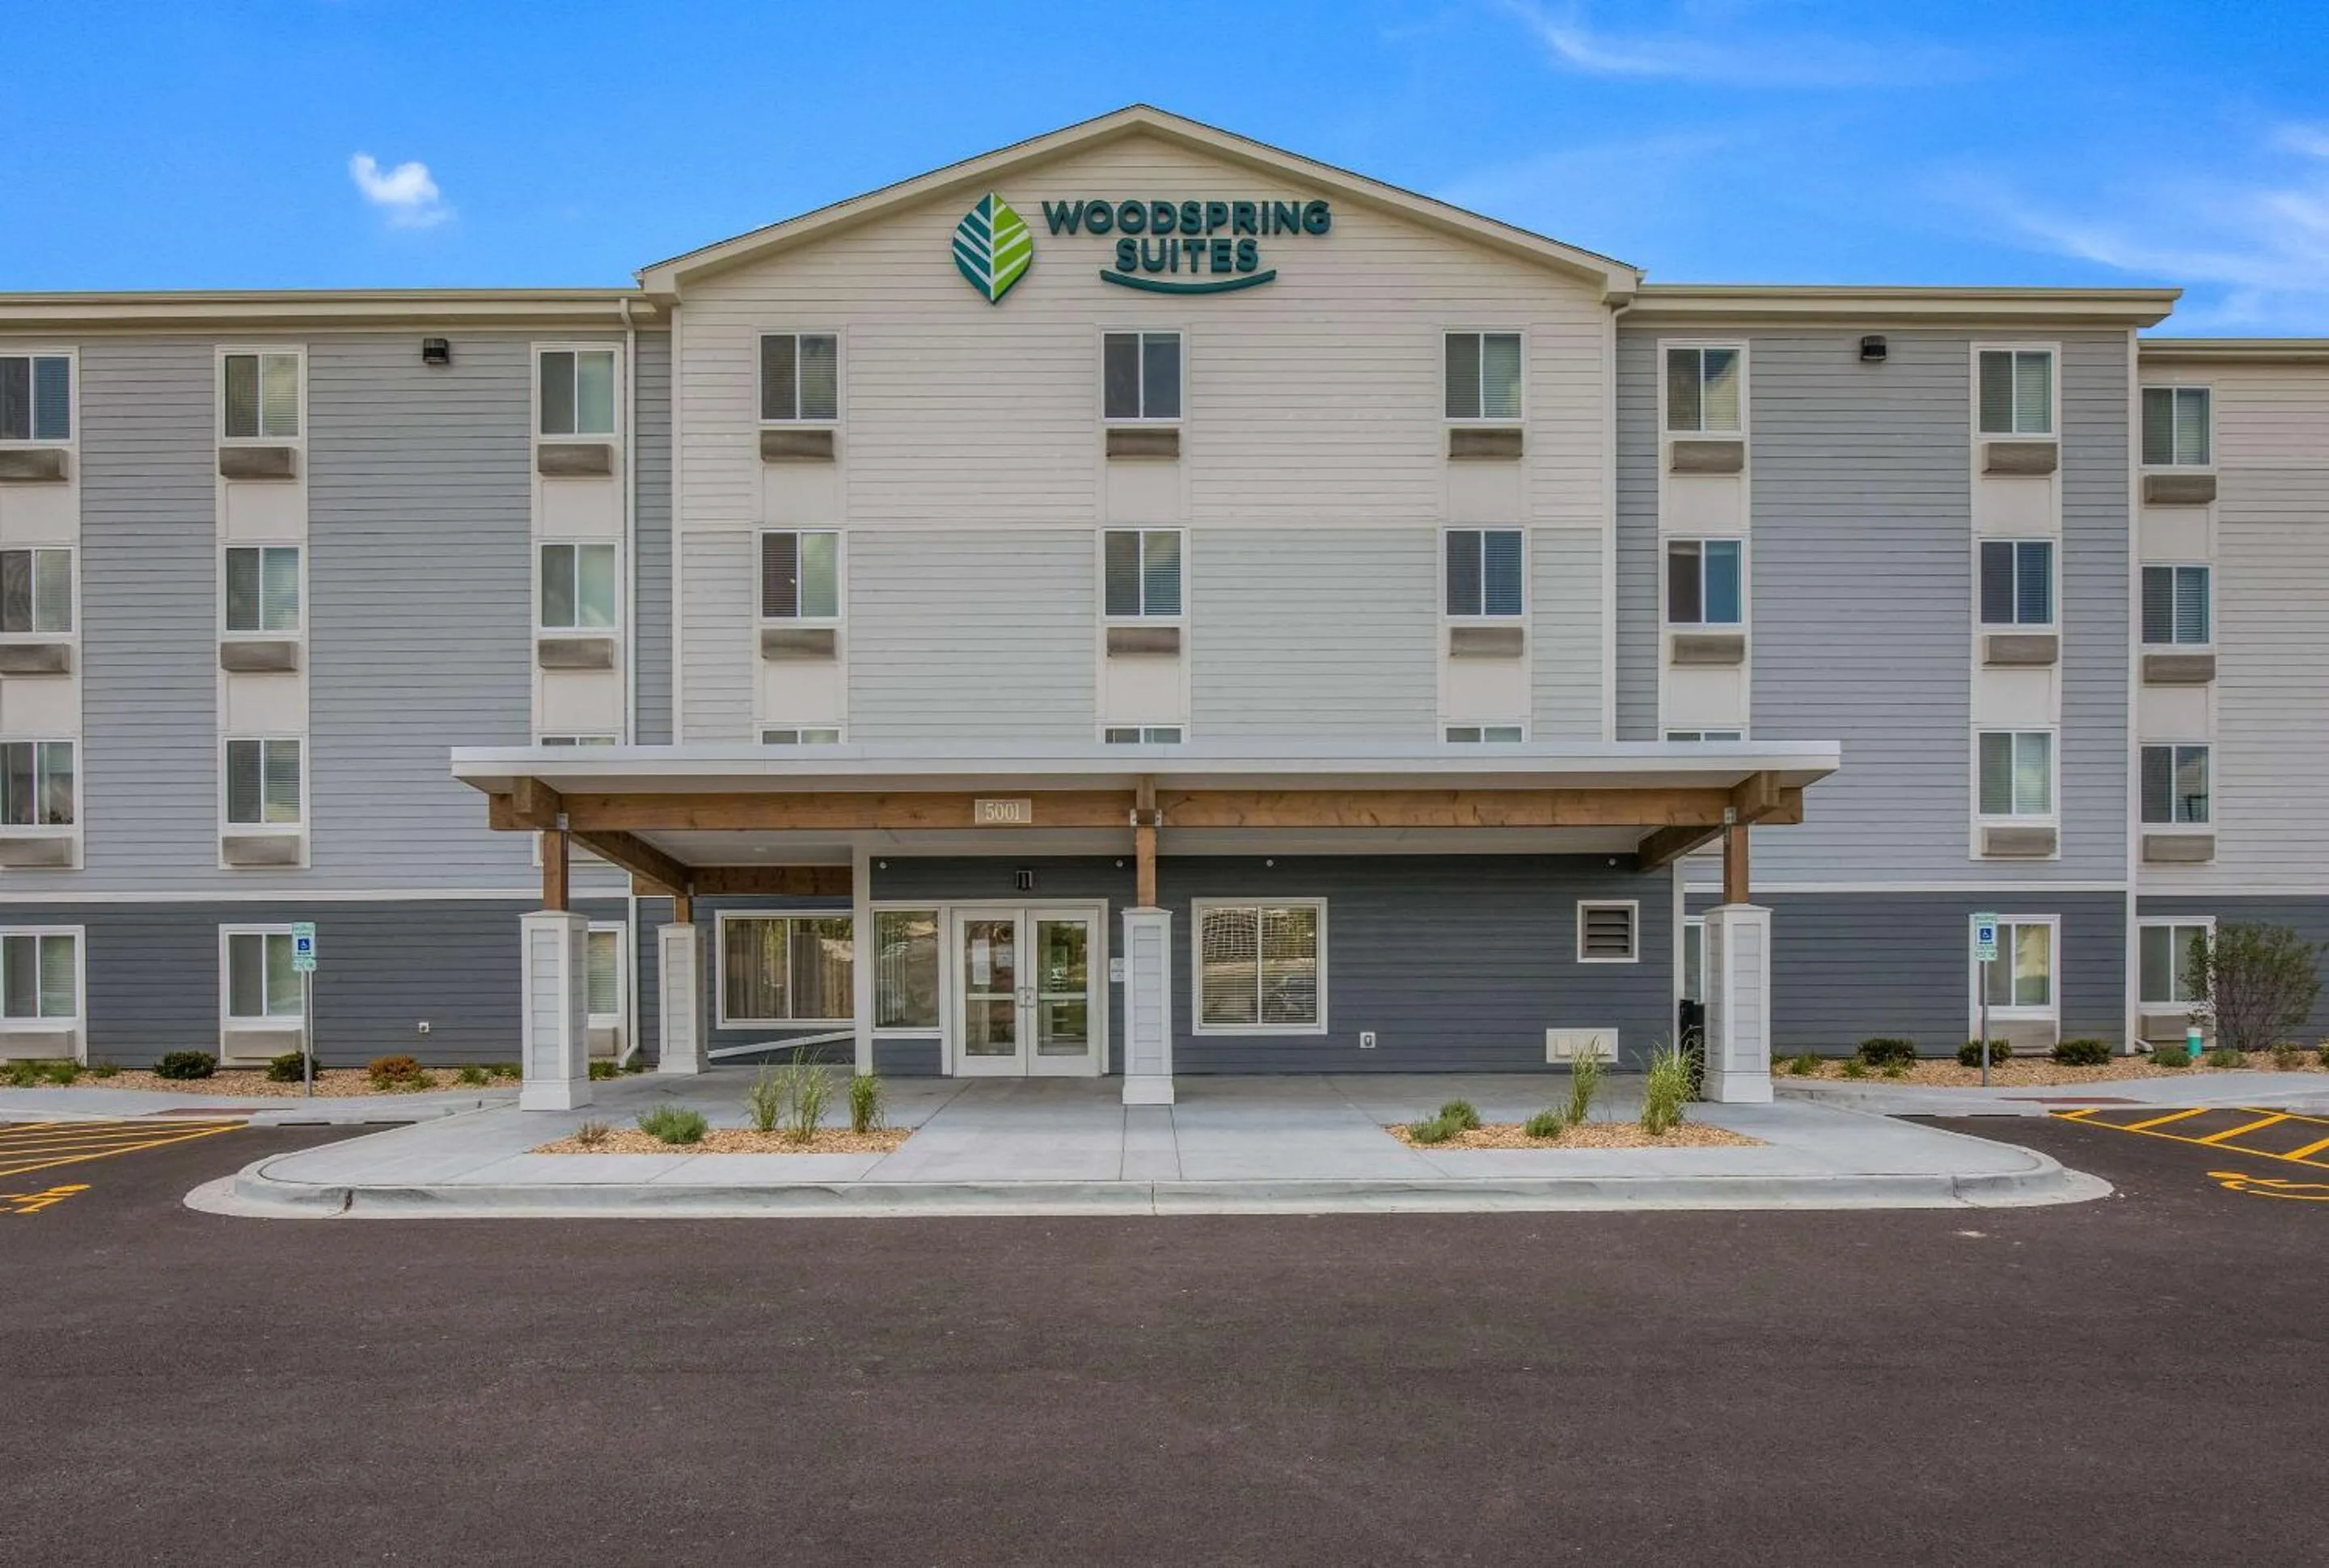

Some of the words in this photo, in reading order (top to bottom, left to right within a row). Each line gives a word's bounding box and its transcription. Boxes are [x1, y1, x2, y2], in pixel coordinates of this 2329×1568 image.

[1042, 200, 1332, 235] WOODSPRING
[1115, 238, 1259, 273] SUITES
[985, 802, 1020, 821] 5001
